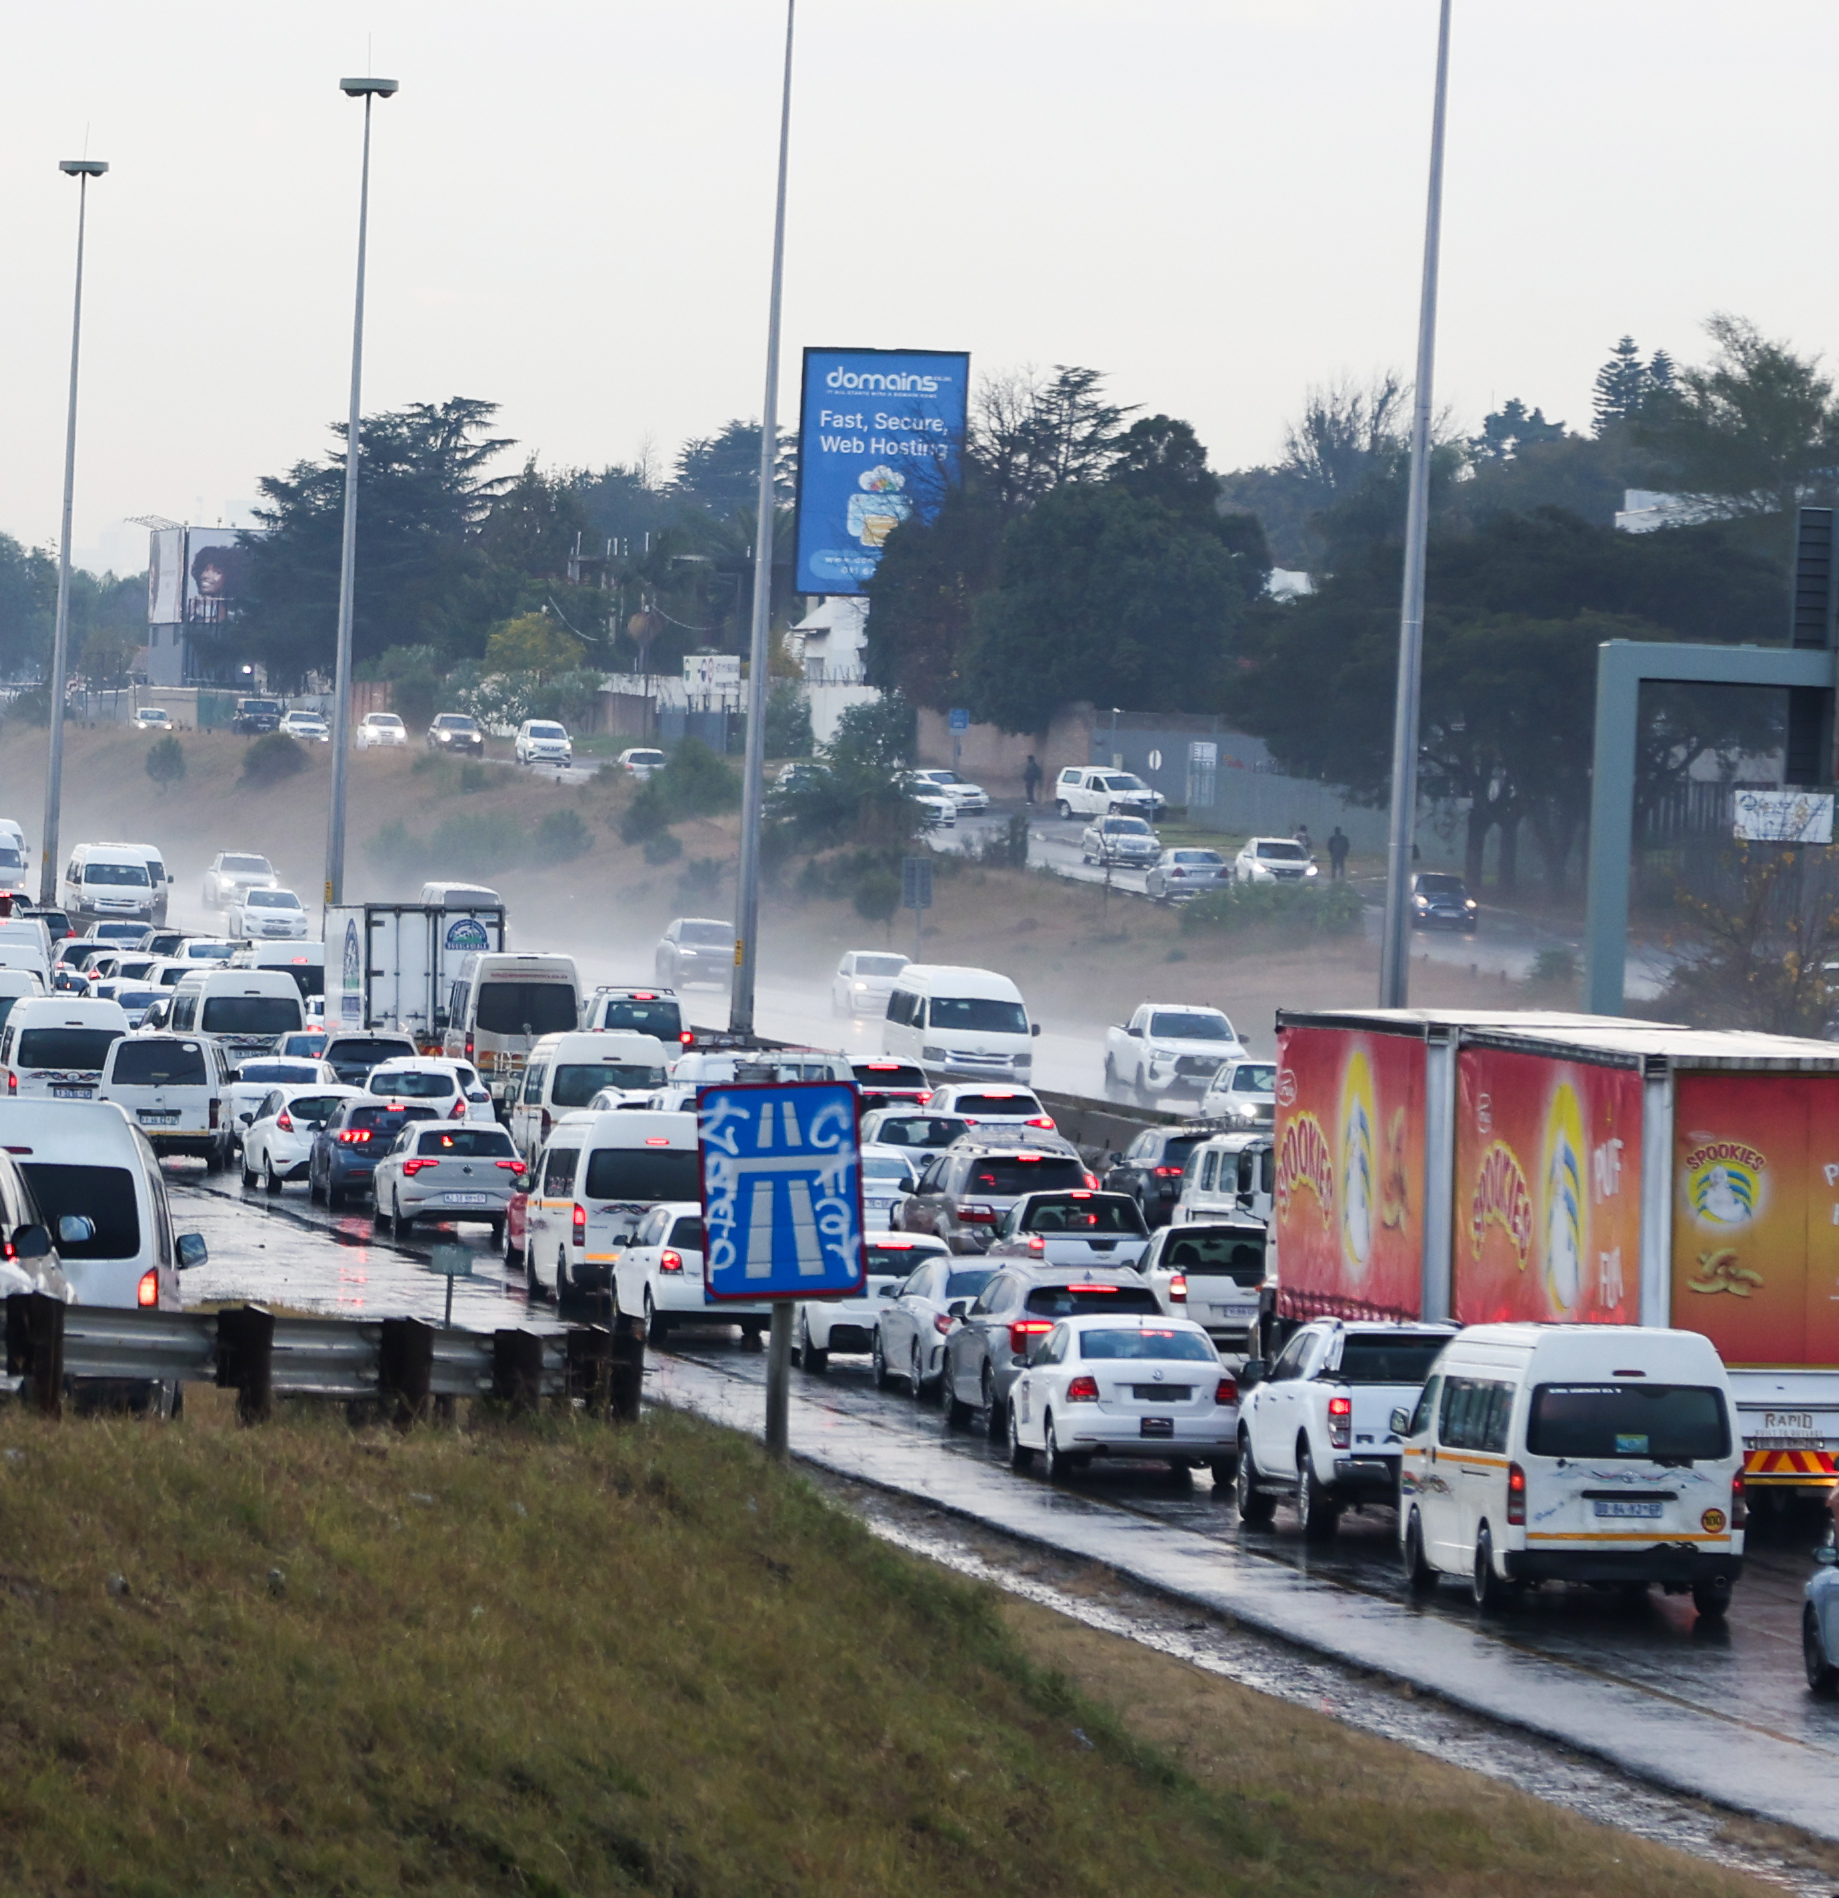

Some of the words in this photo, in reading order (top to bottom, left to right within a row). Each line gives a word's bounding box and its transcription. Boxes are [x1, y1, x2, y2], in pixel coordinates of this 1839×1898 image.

[826, 366, 938, 392] domains
[820, 410, 869, 432] Fast,
[875, 412, 948, 436] Secure,
[820, 435, 865, 454] Web
[870, 437, 949, 461] Hosting
[1685, 1143, 1765, 1171] SPOOKIES
[1765, 1412, 1813, 1429] RAPID
[1705, 1515, 1721, 1526] 100
